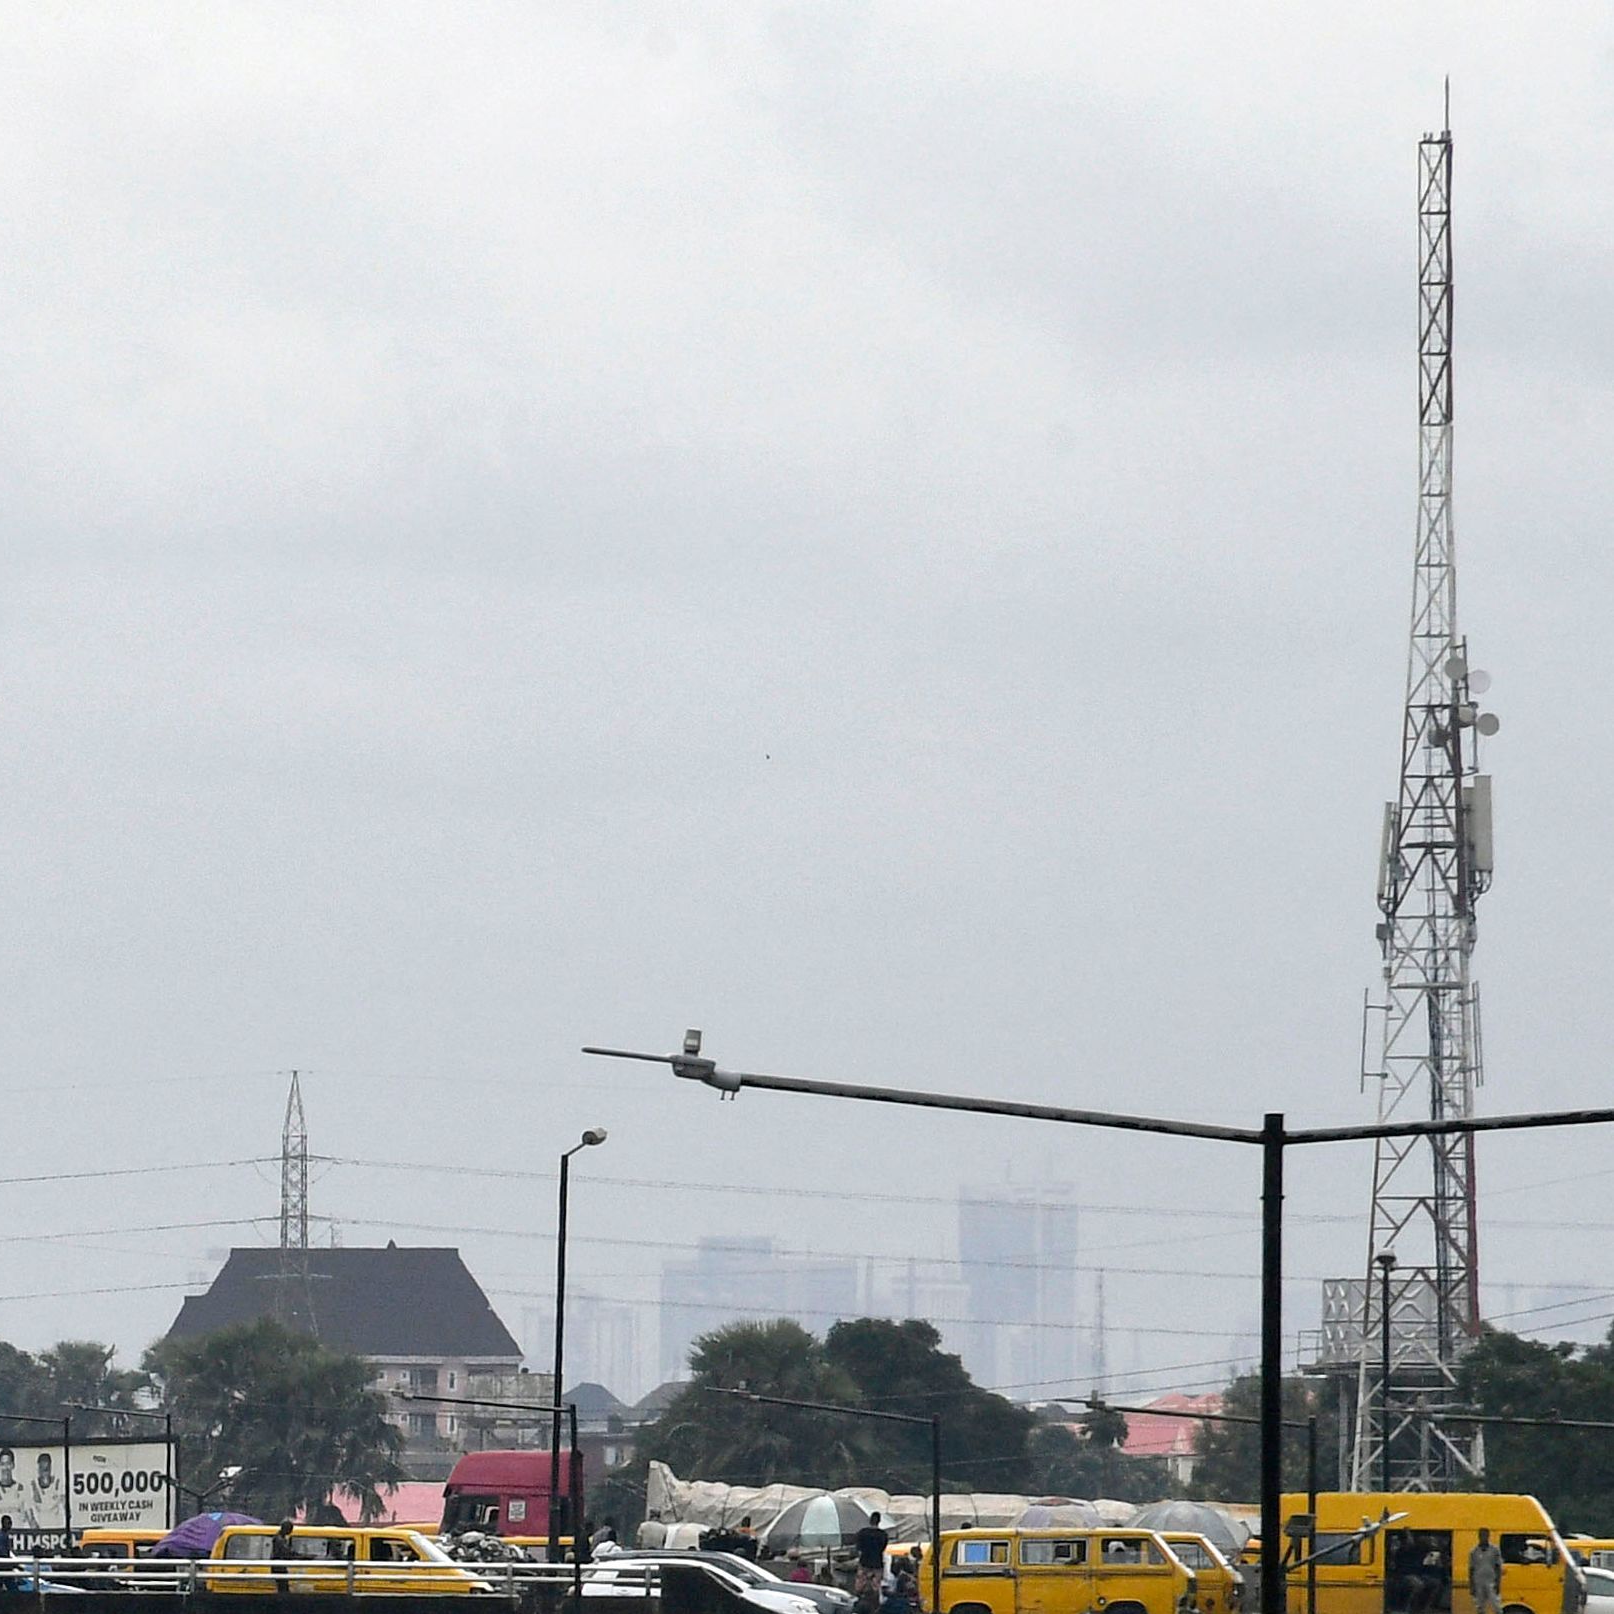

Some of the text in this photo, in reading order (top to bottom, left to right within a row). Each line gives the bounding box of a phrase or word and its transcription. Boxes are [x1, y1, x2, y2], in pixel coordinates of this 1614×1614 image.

[73, 1471, 163, 1498] 500,000
[79, 1500, 153, 1512] IN WEEKLY CASH
[90, 1511, 141, 1523] GIVEAWAY
